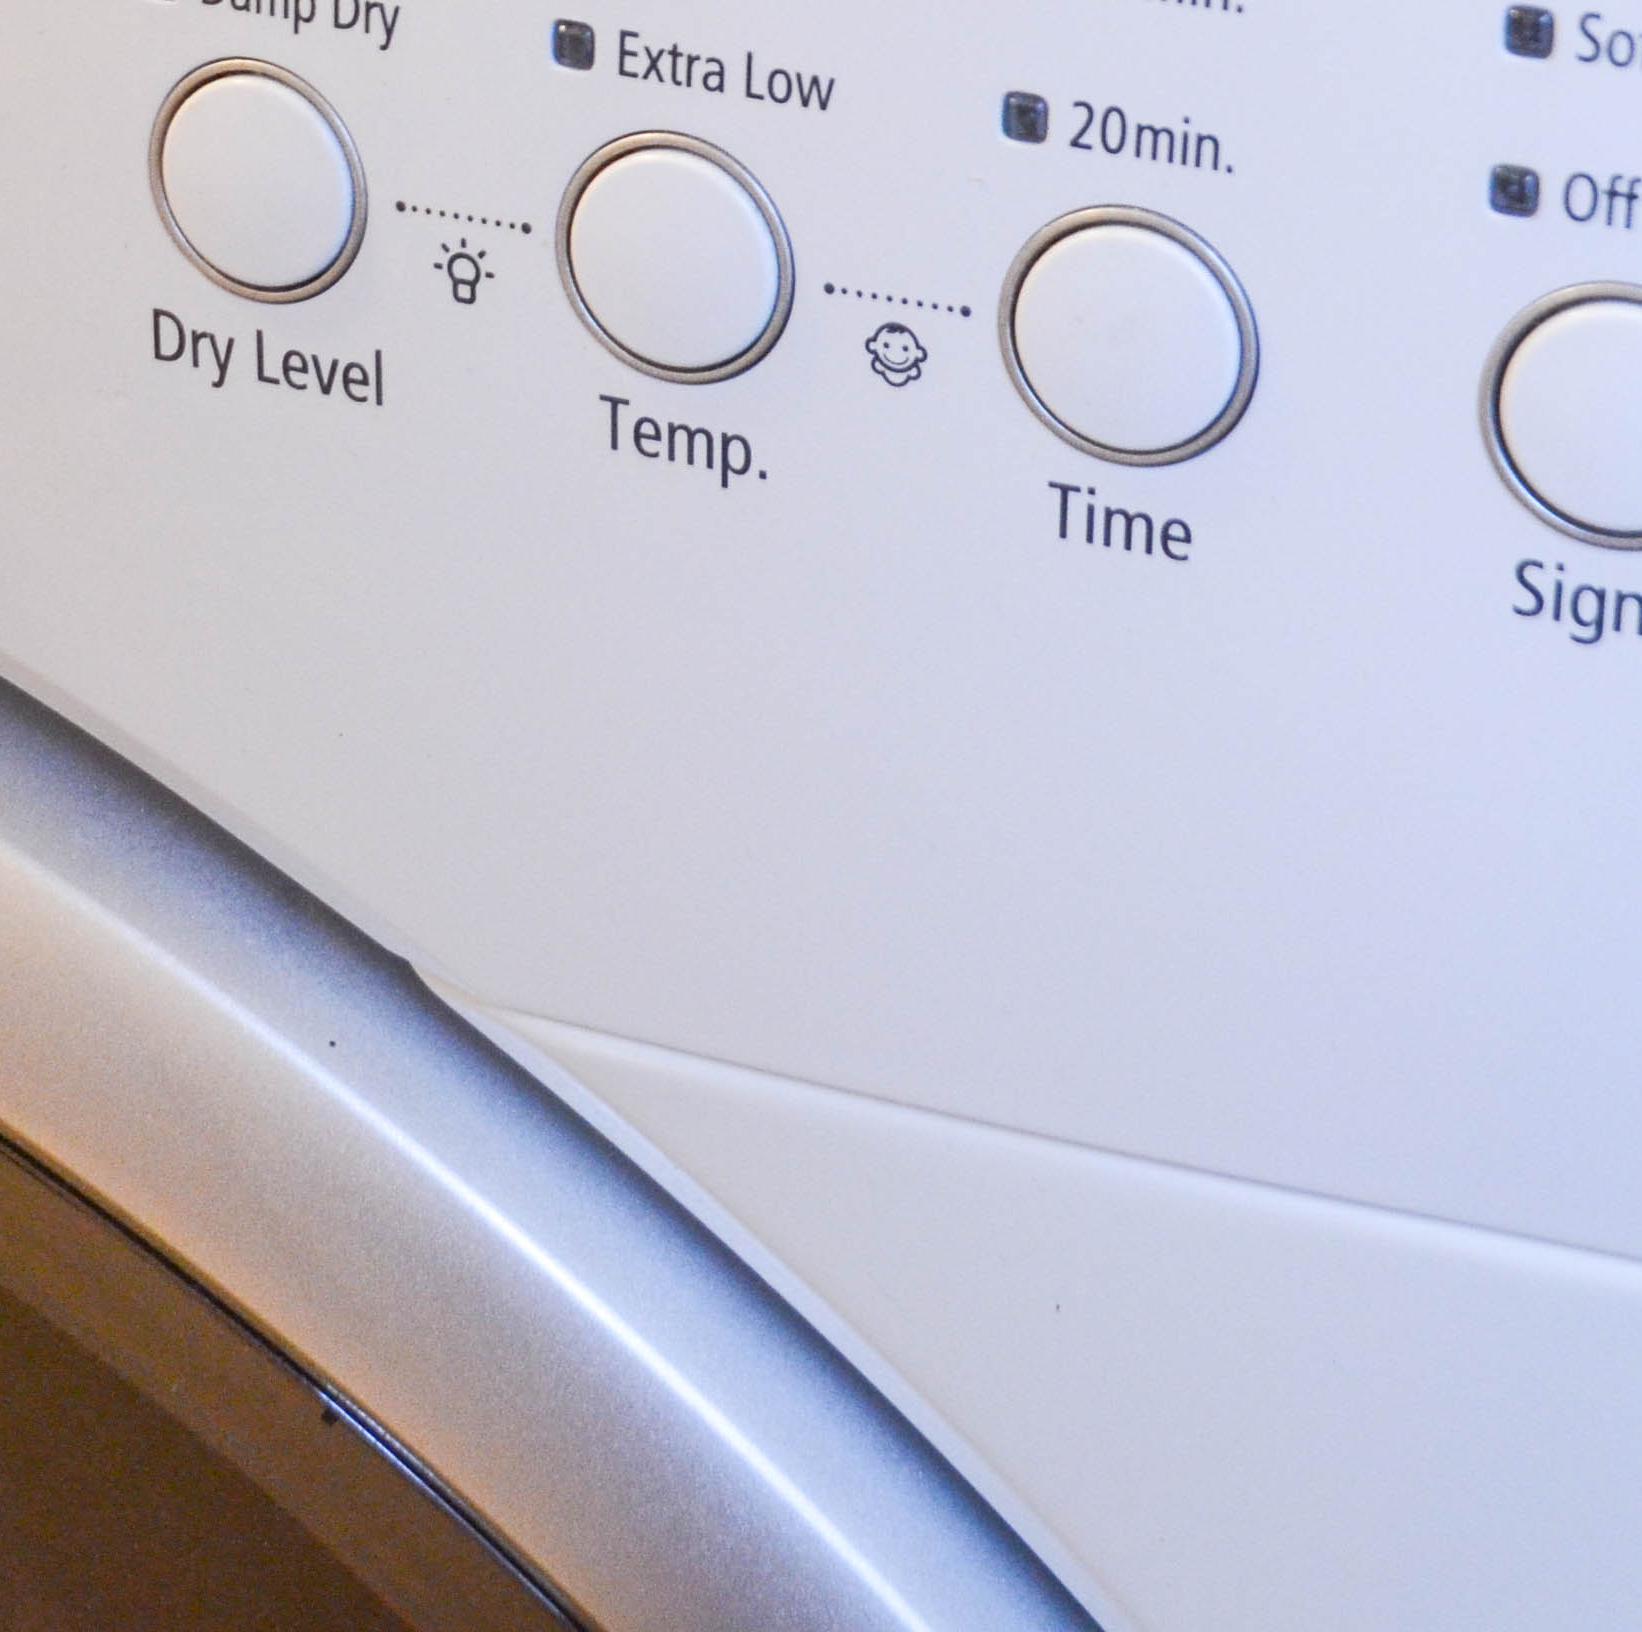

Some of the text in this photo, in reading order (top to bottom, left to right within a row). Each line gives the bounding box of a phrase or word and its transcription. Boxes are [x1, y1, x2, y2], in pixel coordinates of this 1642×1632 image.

[618, 29, 835, 111] Extra Low
[1069, 100, 1233, 174] 20min.
[1563, 172, 1642, 229] Off
[152, 308, 383, 406] Dry Level
[599, 394, 767, 489] Temp.
[1048, 481, 1192, 562] Time
